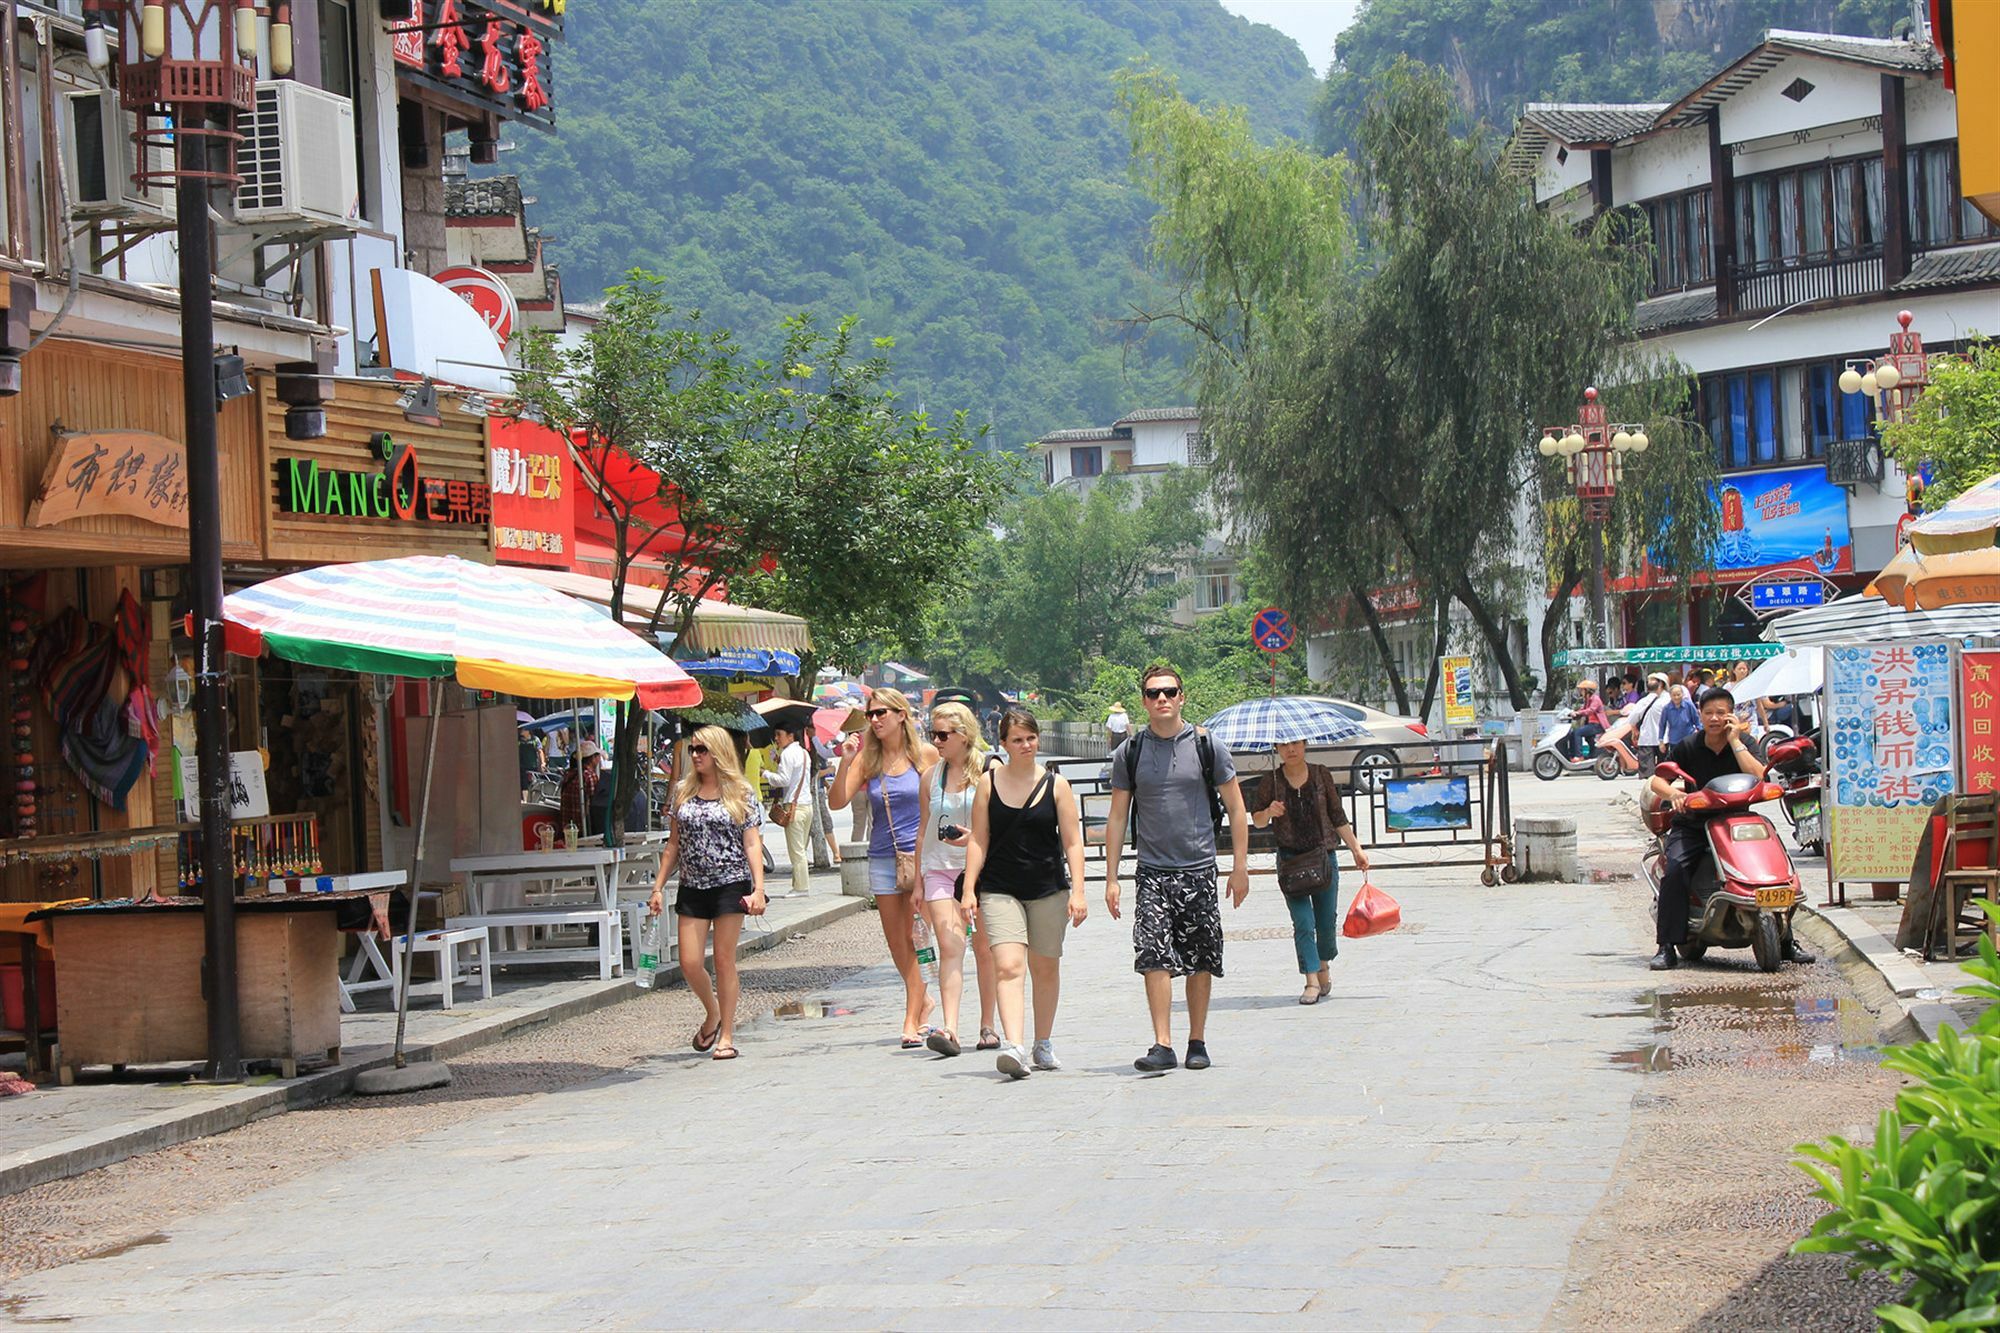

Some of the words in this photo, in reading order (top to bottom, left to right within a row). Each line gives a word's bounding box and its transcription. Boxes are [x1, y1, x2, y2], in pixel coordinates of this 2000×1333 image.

[290, 443, 418, 520] MANGO
[491, 446, 562, 500] 魔力芒果
[1937, 586, 1967, 600] 电话
[1871, 647, 1921, 801] 洪昇钱币社
[1970, 663, 1996, 790] 高价回收黄
[1756, 889, 1794, 904] 34987
